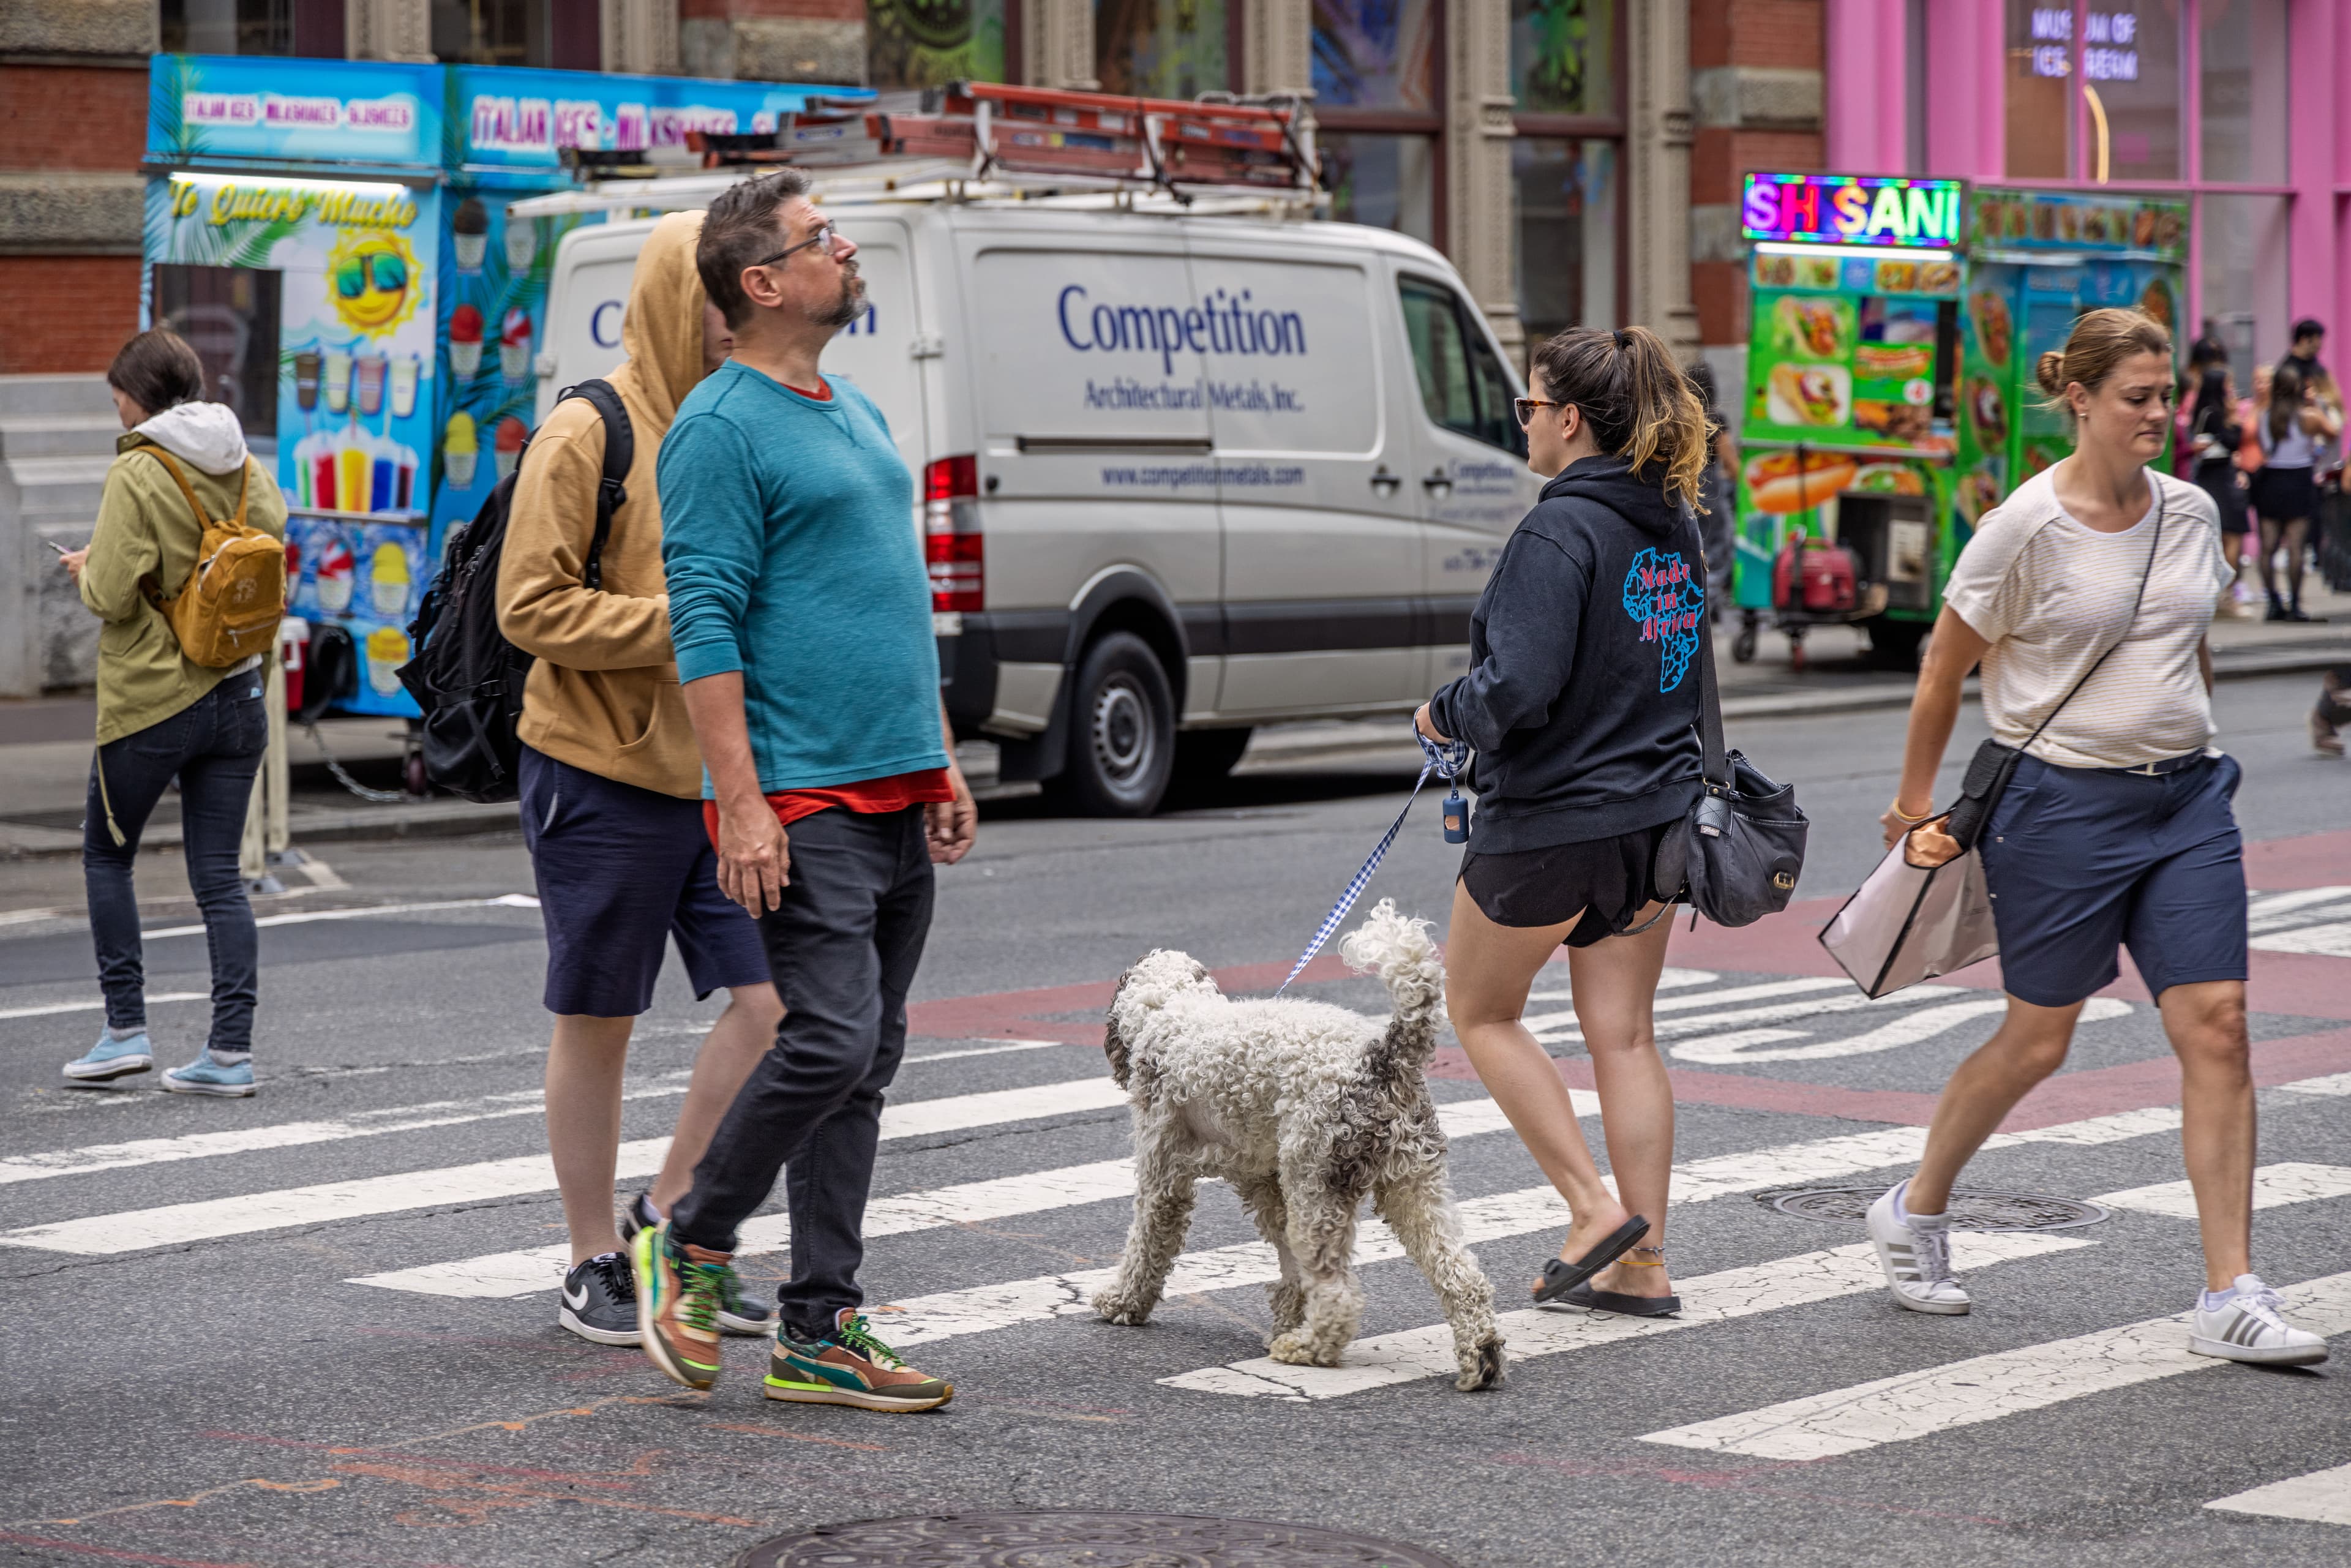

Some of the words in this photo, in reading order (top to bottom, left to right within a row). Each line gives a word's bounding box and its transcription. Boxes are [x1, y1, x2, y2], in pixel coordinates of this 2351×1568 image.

[473, 101, 547, 144] ITALIAN
[170, 181, 198, 217] Te
[208, 183, 304, 226] Quiero
[315, 189, 418, 228] Mucho
[1744, 182, 1818, 231] SH
[1833, 185, 1959, 239] SANI
[1057, 285, 1306, 375] Competition
[1085, 378, 1201, 409] Architectural
[1102, 463, 1305, 489] www.competitionmetals.com
[1640, 560, 1690, 591] Made
[1657, 592, 1678, 610] in
[1640, 612, 1697, 643] Africa
